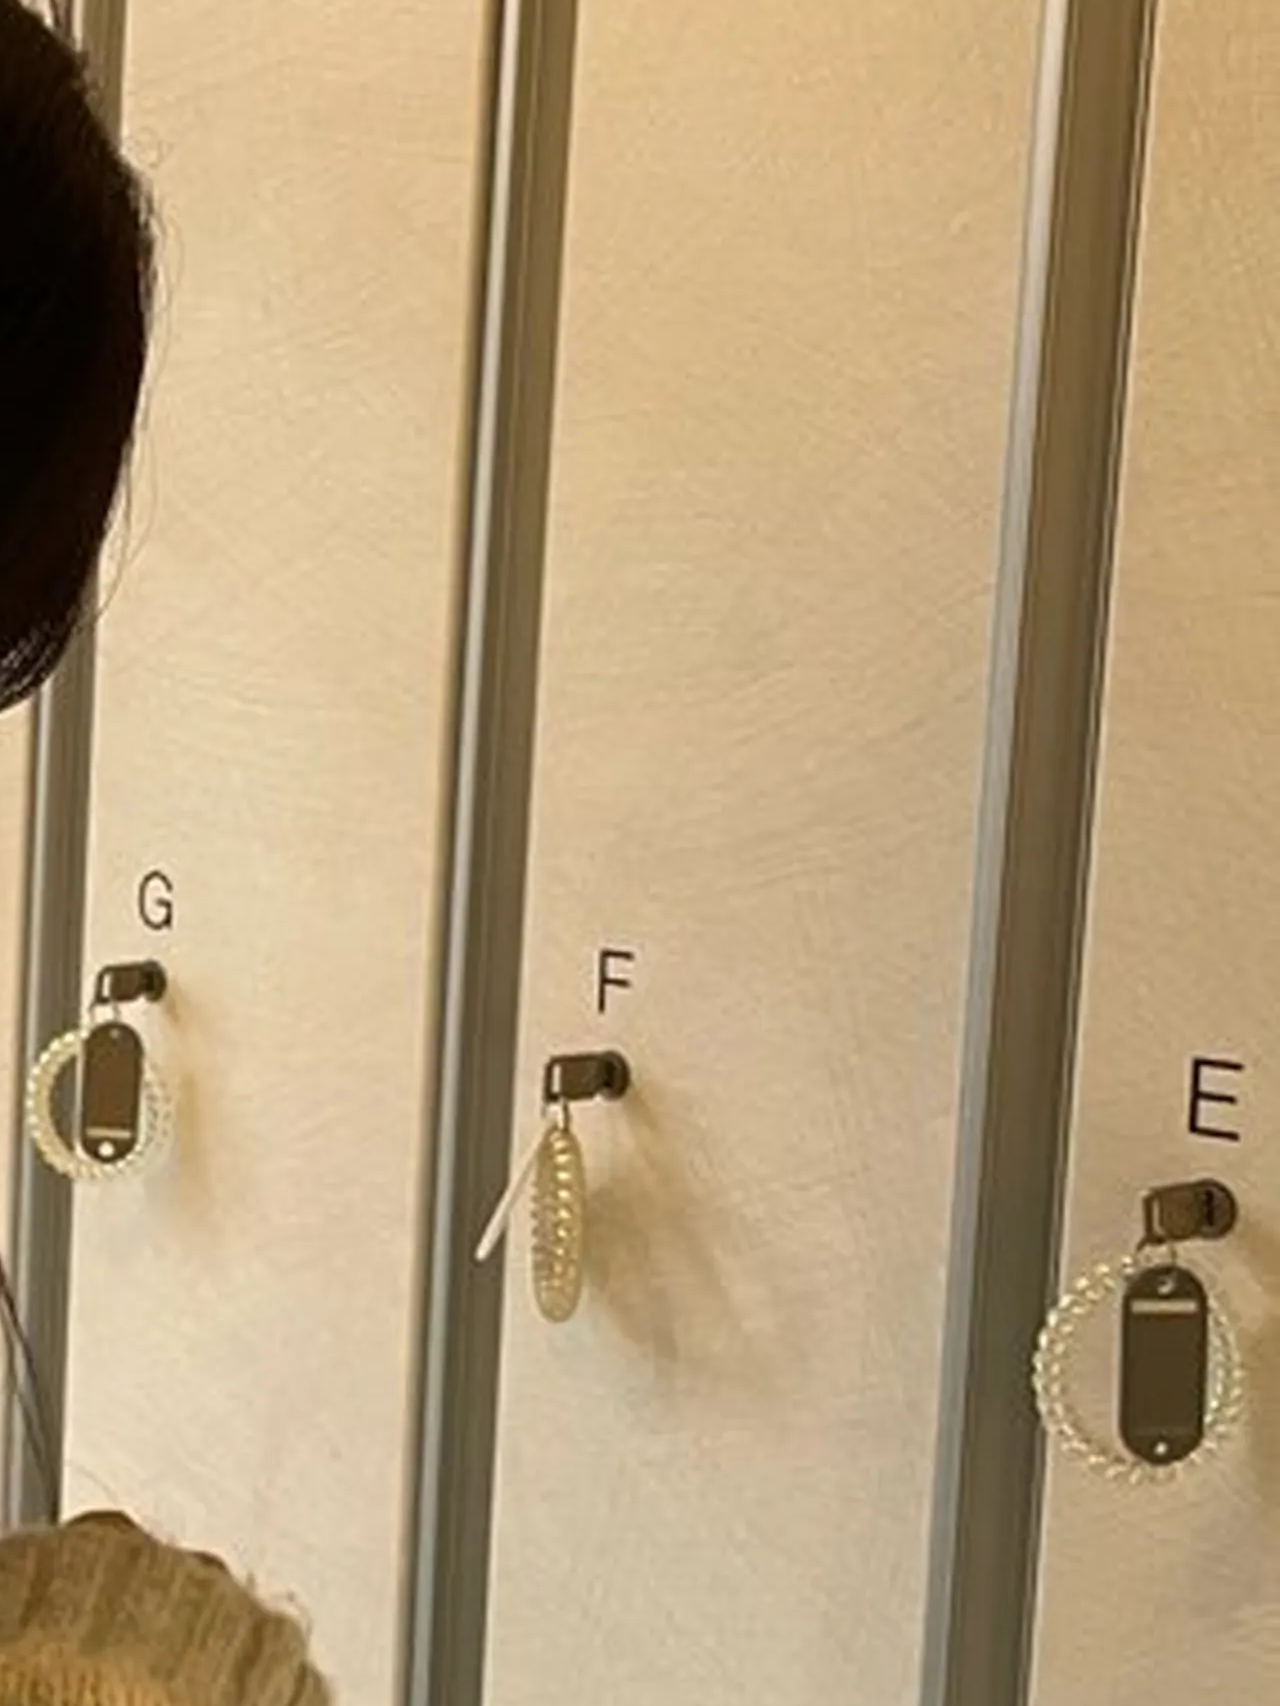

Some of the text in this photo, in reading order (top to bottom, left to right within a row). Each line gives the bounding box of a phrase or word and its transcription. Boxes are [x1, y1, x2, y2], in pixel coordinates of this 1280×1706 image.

[138, 870, 173, 931] G
[598, 948, 635, 1015] F
[1189, 1057, 1244, 1142] E
